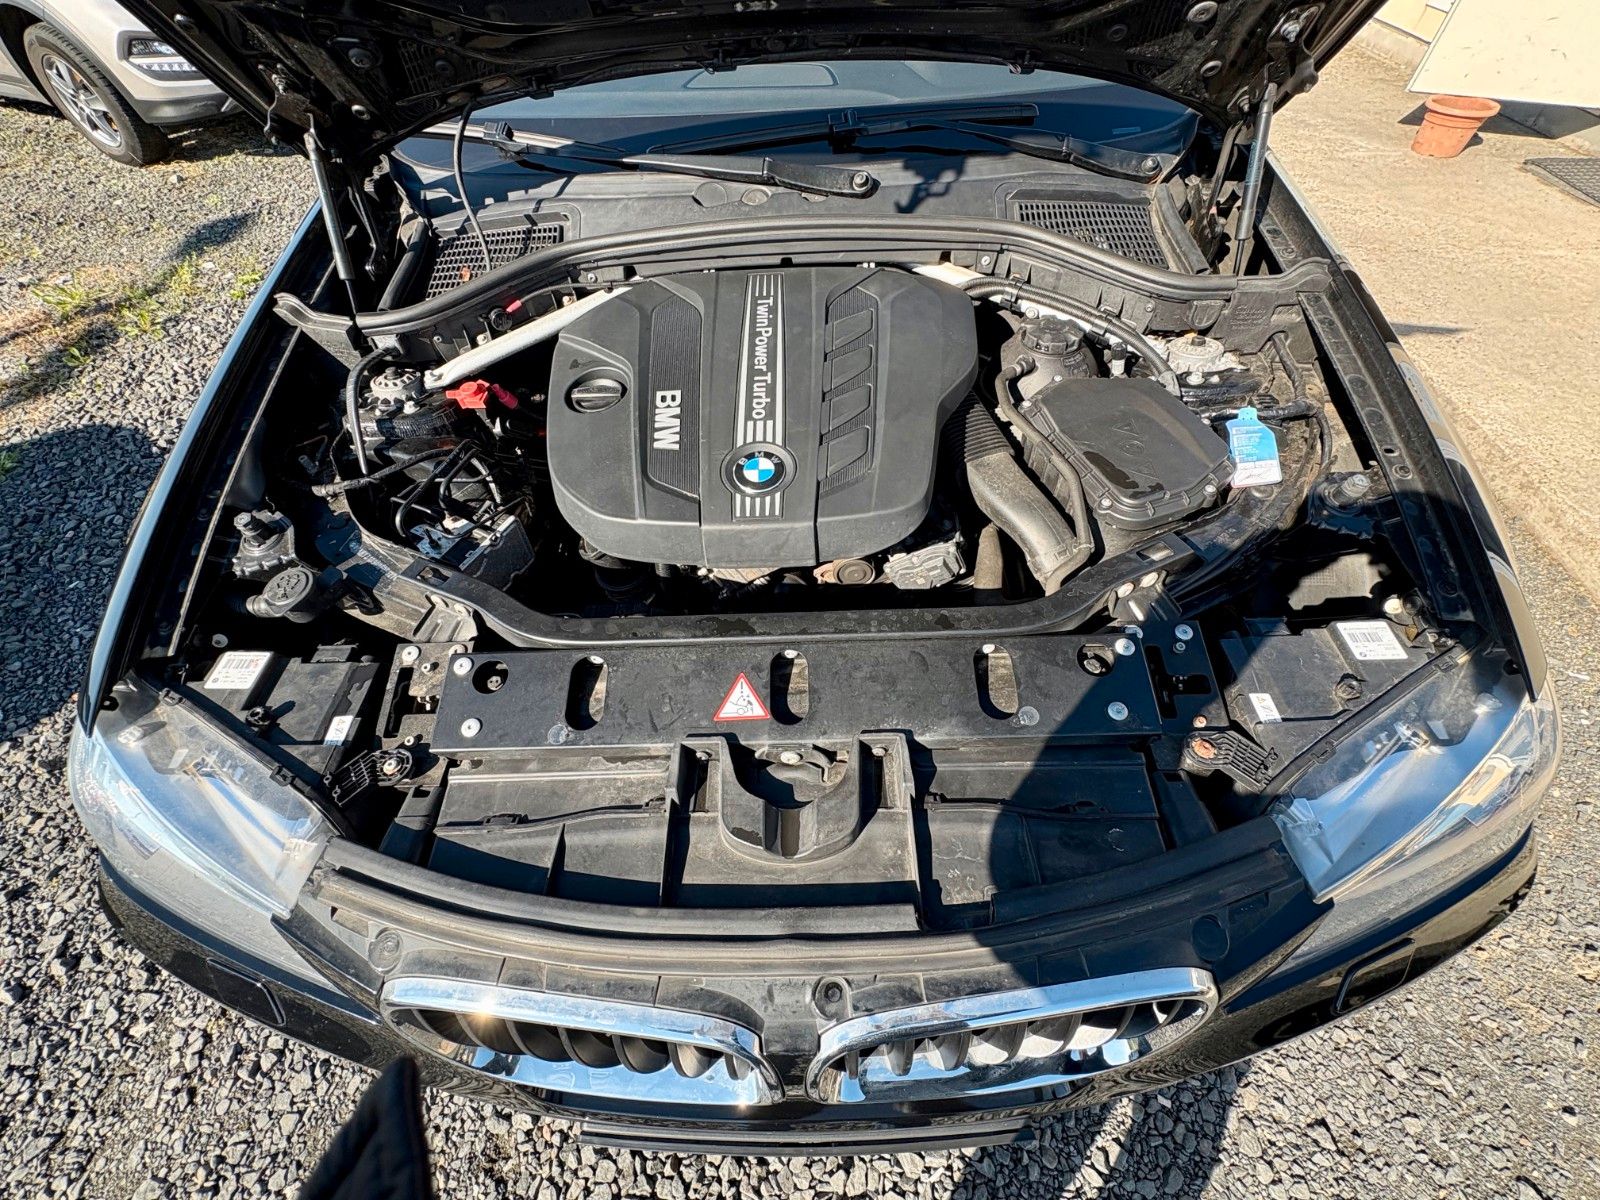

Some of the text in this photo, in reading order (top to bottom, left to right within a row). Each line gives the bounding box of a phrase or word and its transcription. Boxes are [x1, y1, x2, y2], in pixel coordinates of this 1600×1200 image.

[752, 296, 774, 419] TwinPower Turbo
[653, 389, 682, 450] BMW
[738, 452, 782, 465] BMW
